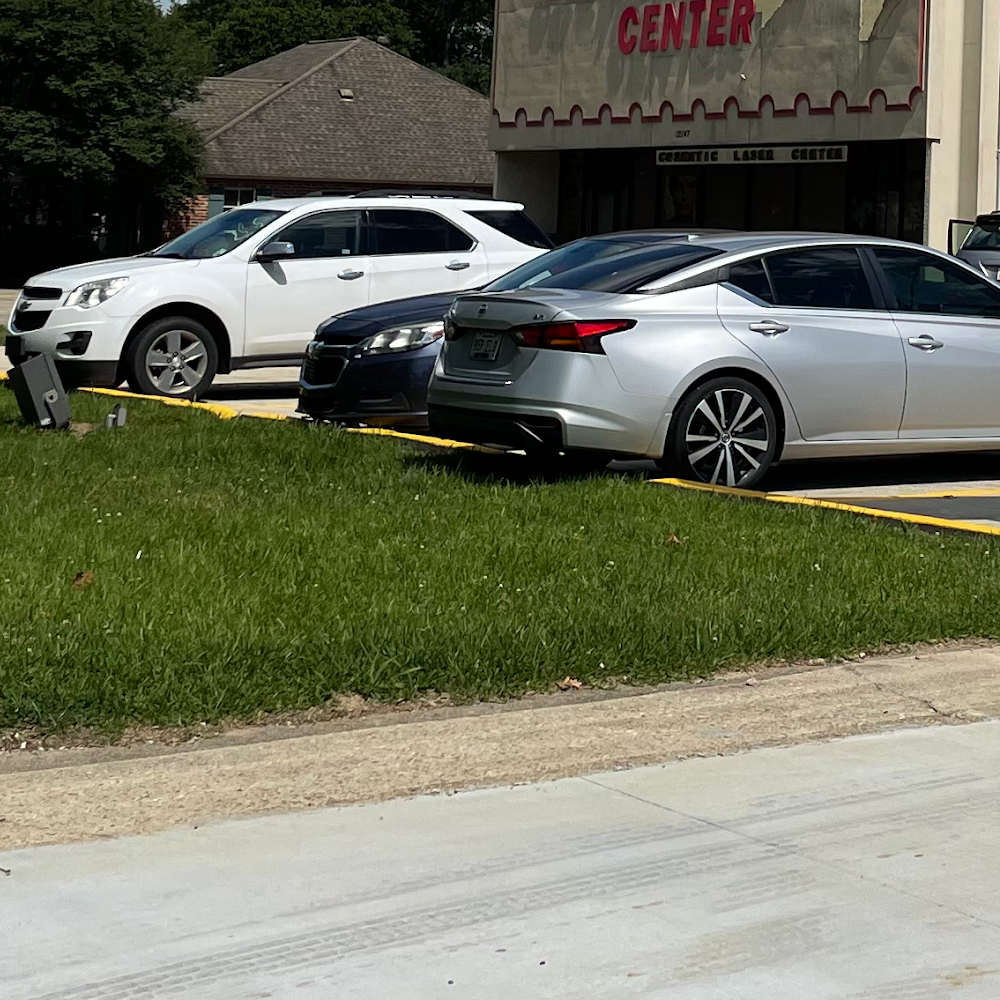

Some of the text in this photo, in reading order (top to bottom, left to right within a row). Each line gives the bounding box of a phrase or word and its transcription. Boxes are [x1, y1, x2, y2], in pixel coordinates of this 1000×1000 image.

[658, 148, 844, 163] COSMETIC LASER CENTER
